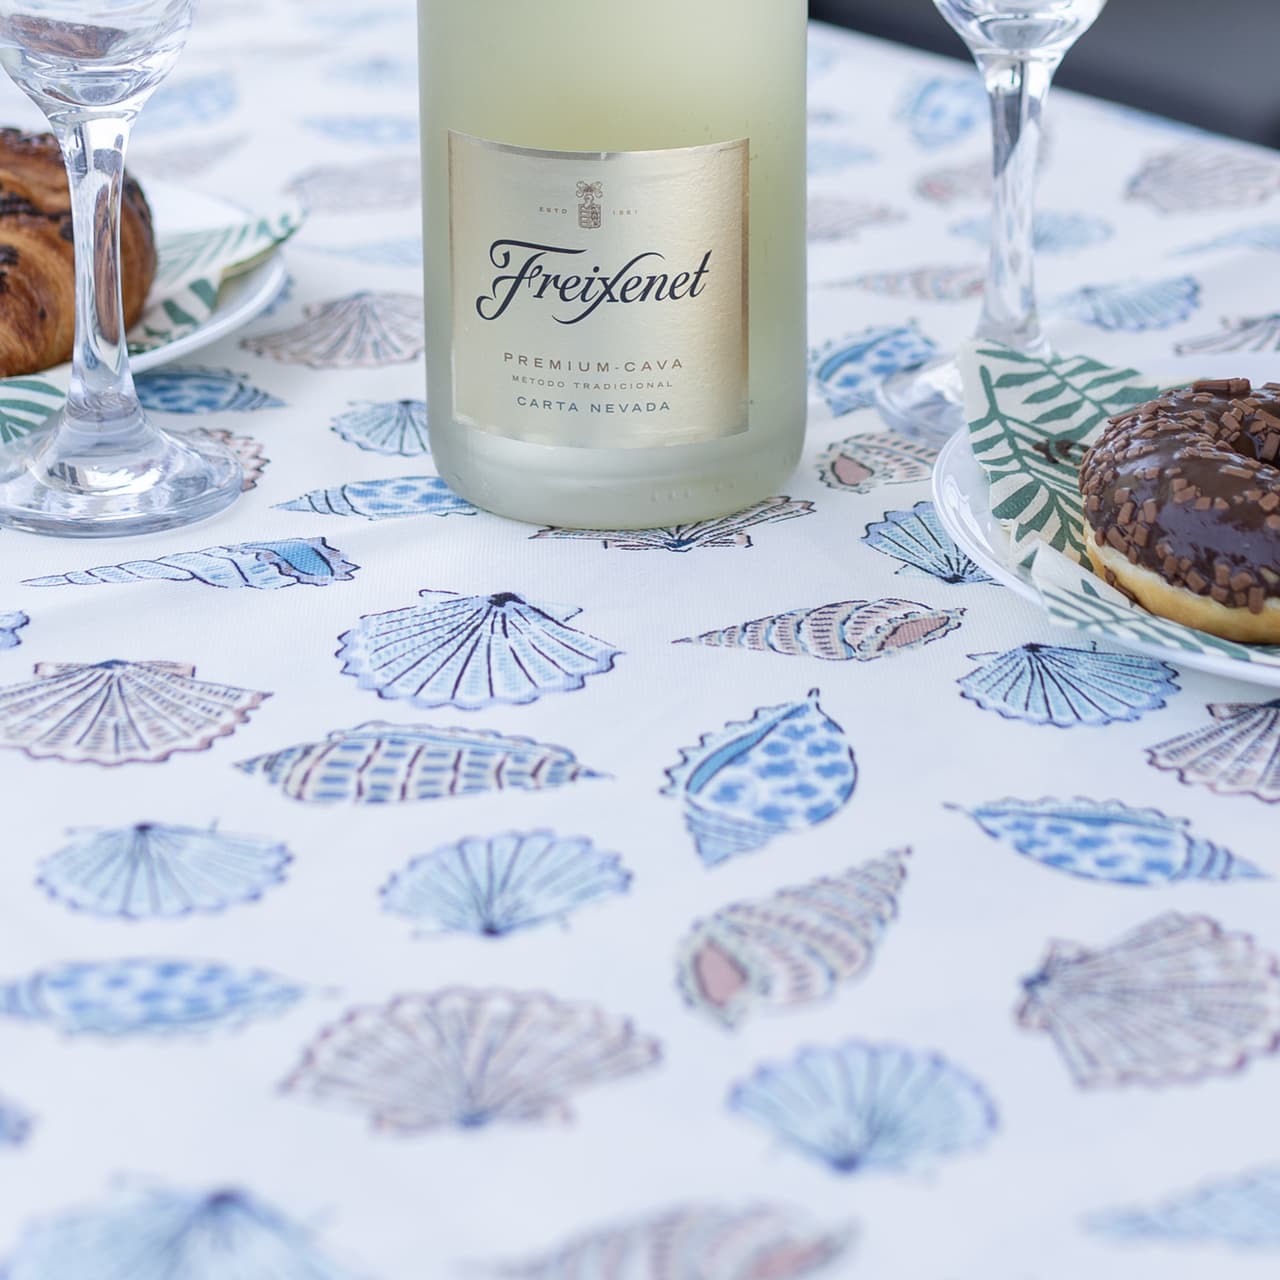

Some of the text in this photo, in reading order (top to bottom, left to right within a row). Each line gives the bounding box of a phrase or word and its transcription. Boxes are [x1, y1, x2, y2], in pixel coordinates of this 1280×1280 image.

[476, 239, 713, 325] Freixenet
[573, 380, 673, 391] TRADICIONAL
[516, 396, 671, 414] CARTA NEVADA
